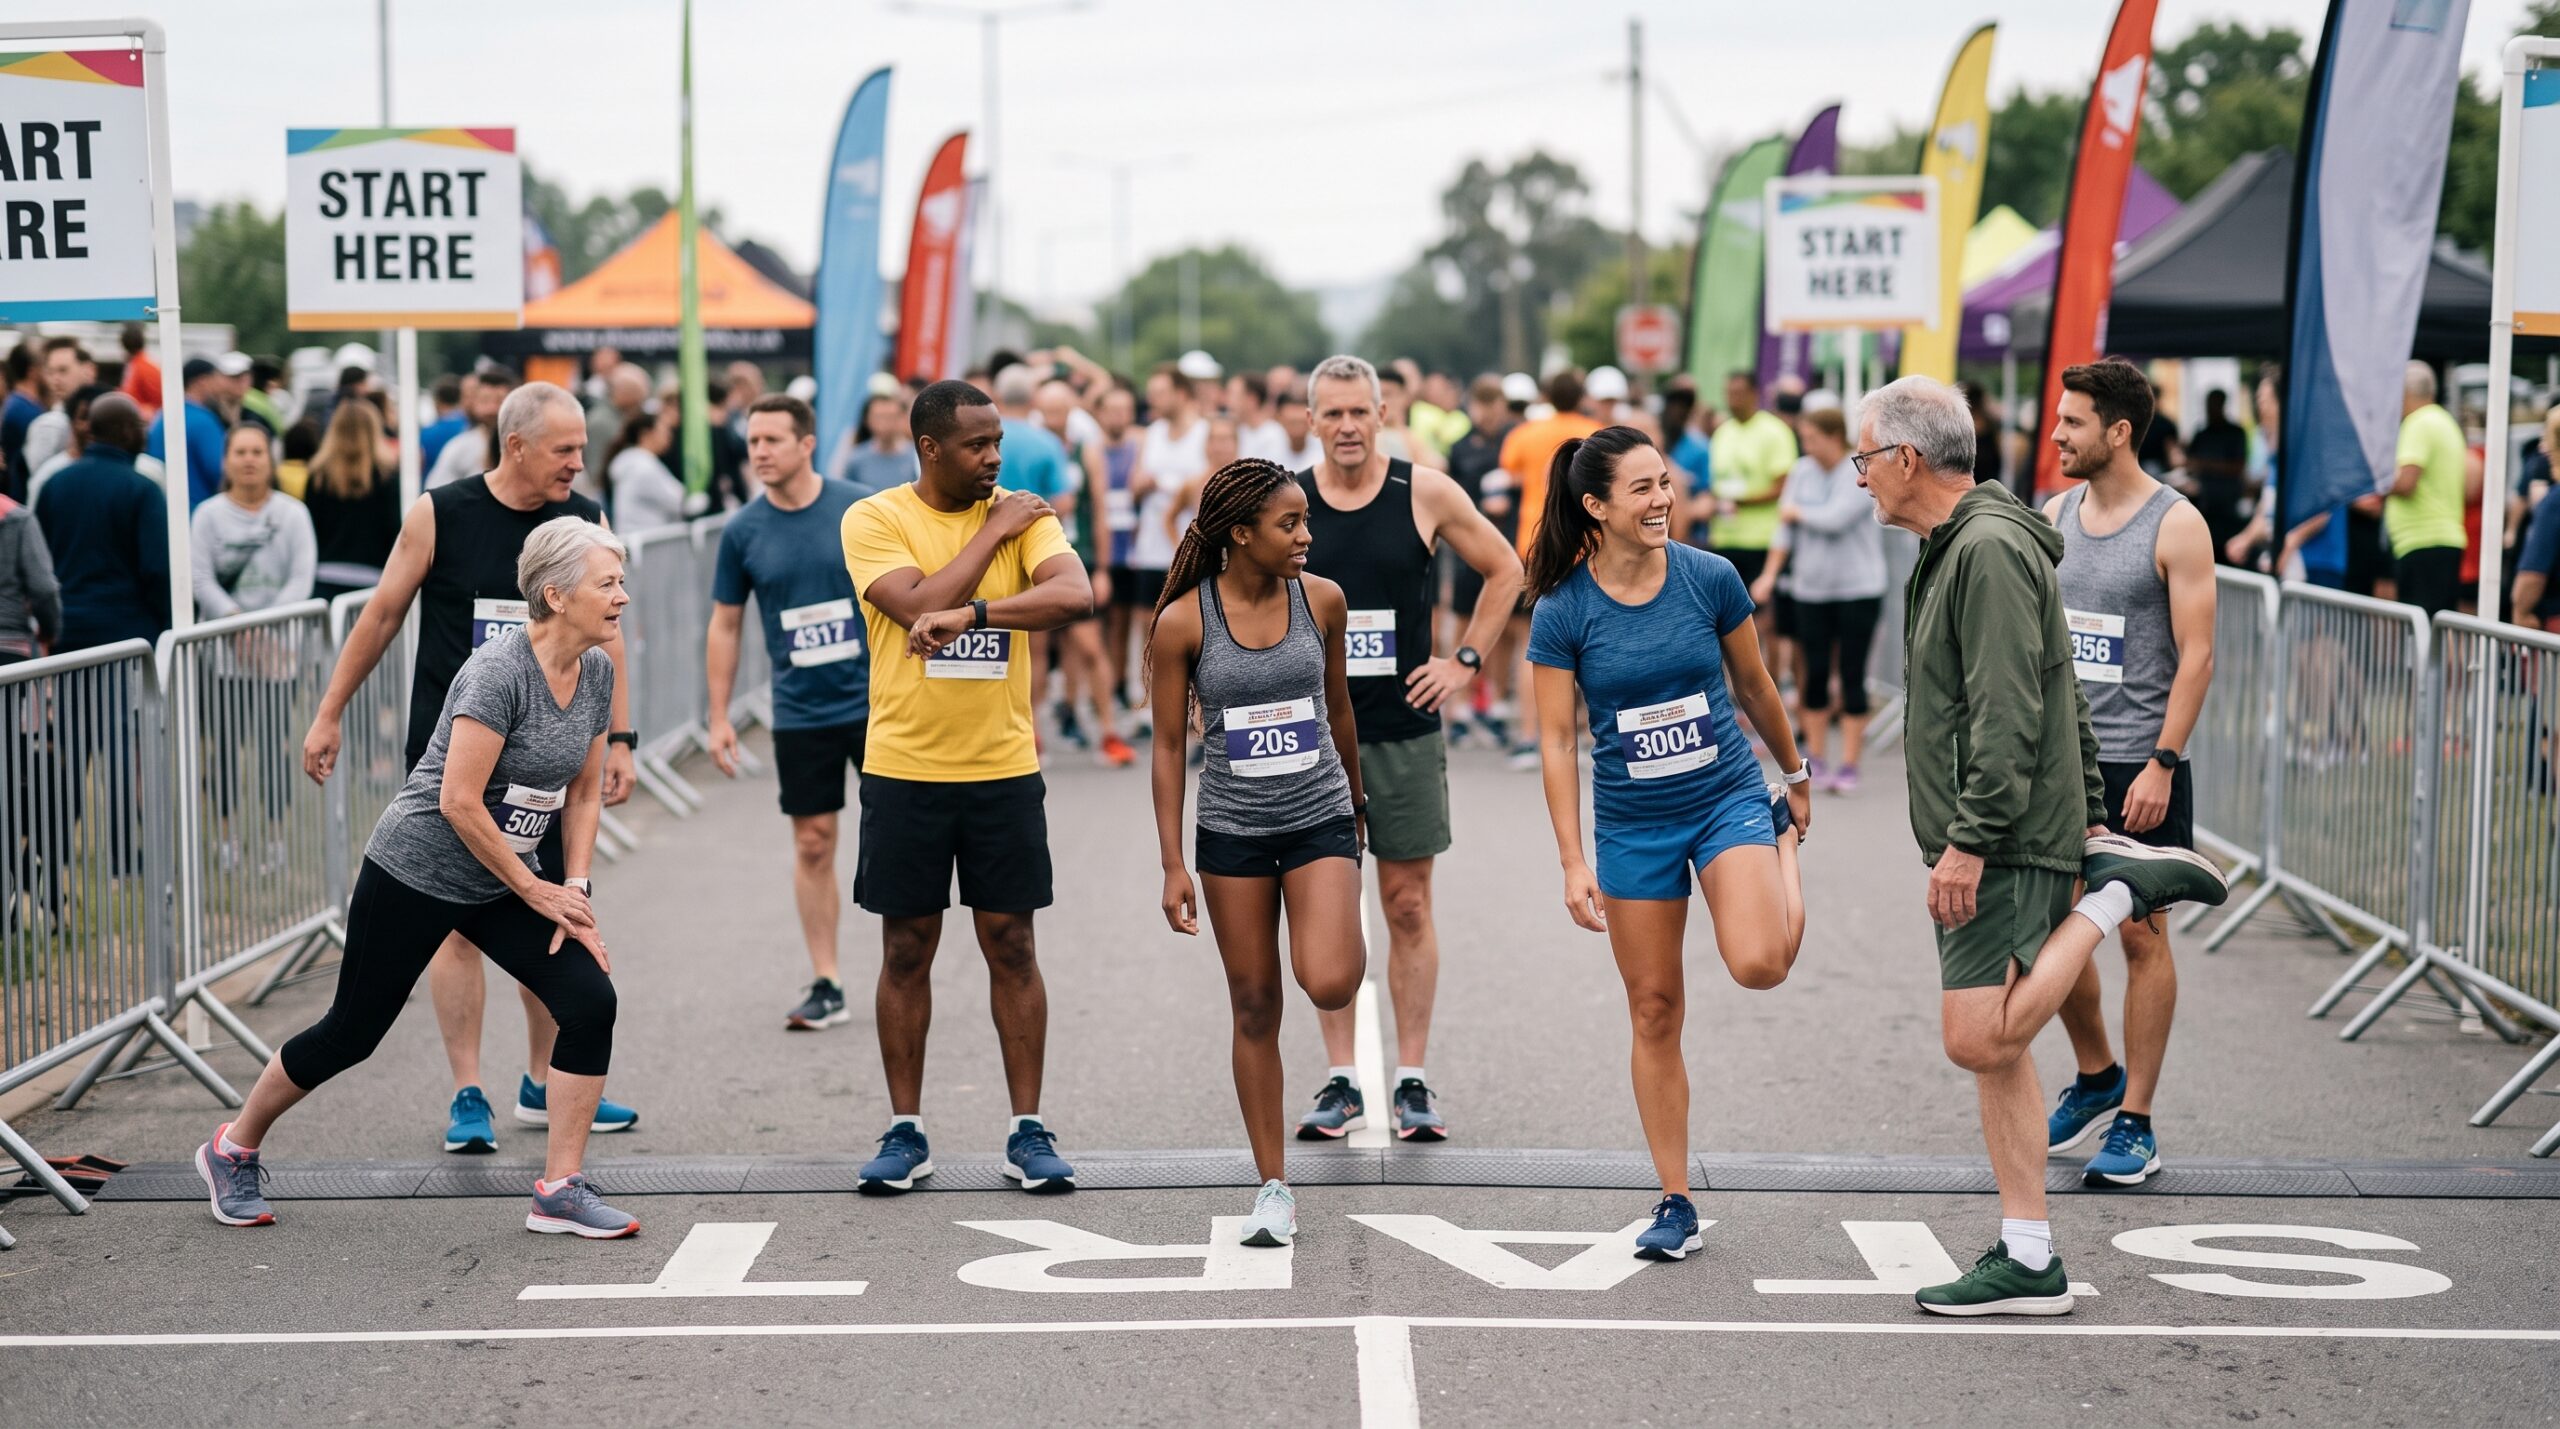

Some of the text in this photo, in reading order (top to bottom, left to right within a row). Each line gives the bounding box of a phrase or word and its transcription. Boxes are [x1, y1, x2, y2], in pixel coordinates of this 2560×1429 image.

[319, 171, 487, 218] START
[334, 235, 474, 280] HERE
[1801, 227, 1905, 257] START
[1809, 268, 1894, 298] HERE
[793, 620, 846, 649] 4317
[1248, 728, 1299, 757] 20s
[1633, 721, 1703, 759] 3004
[518, 1213, 2452, 1301] START
